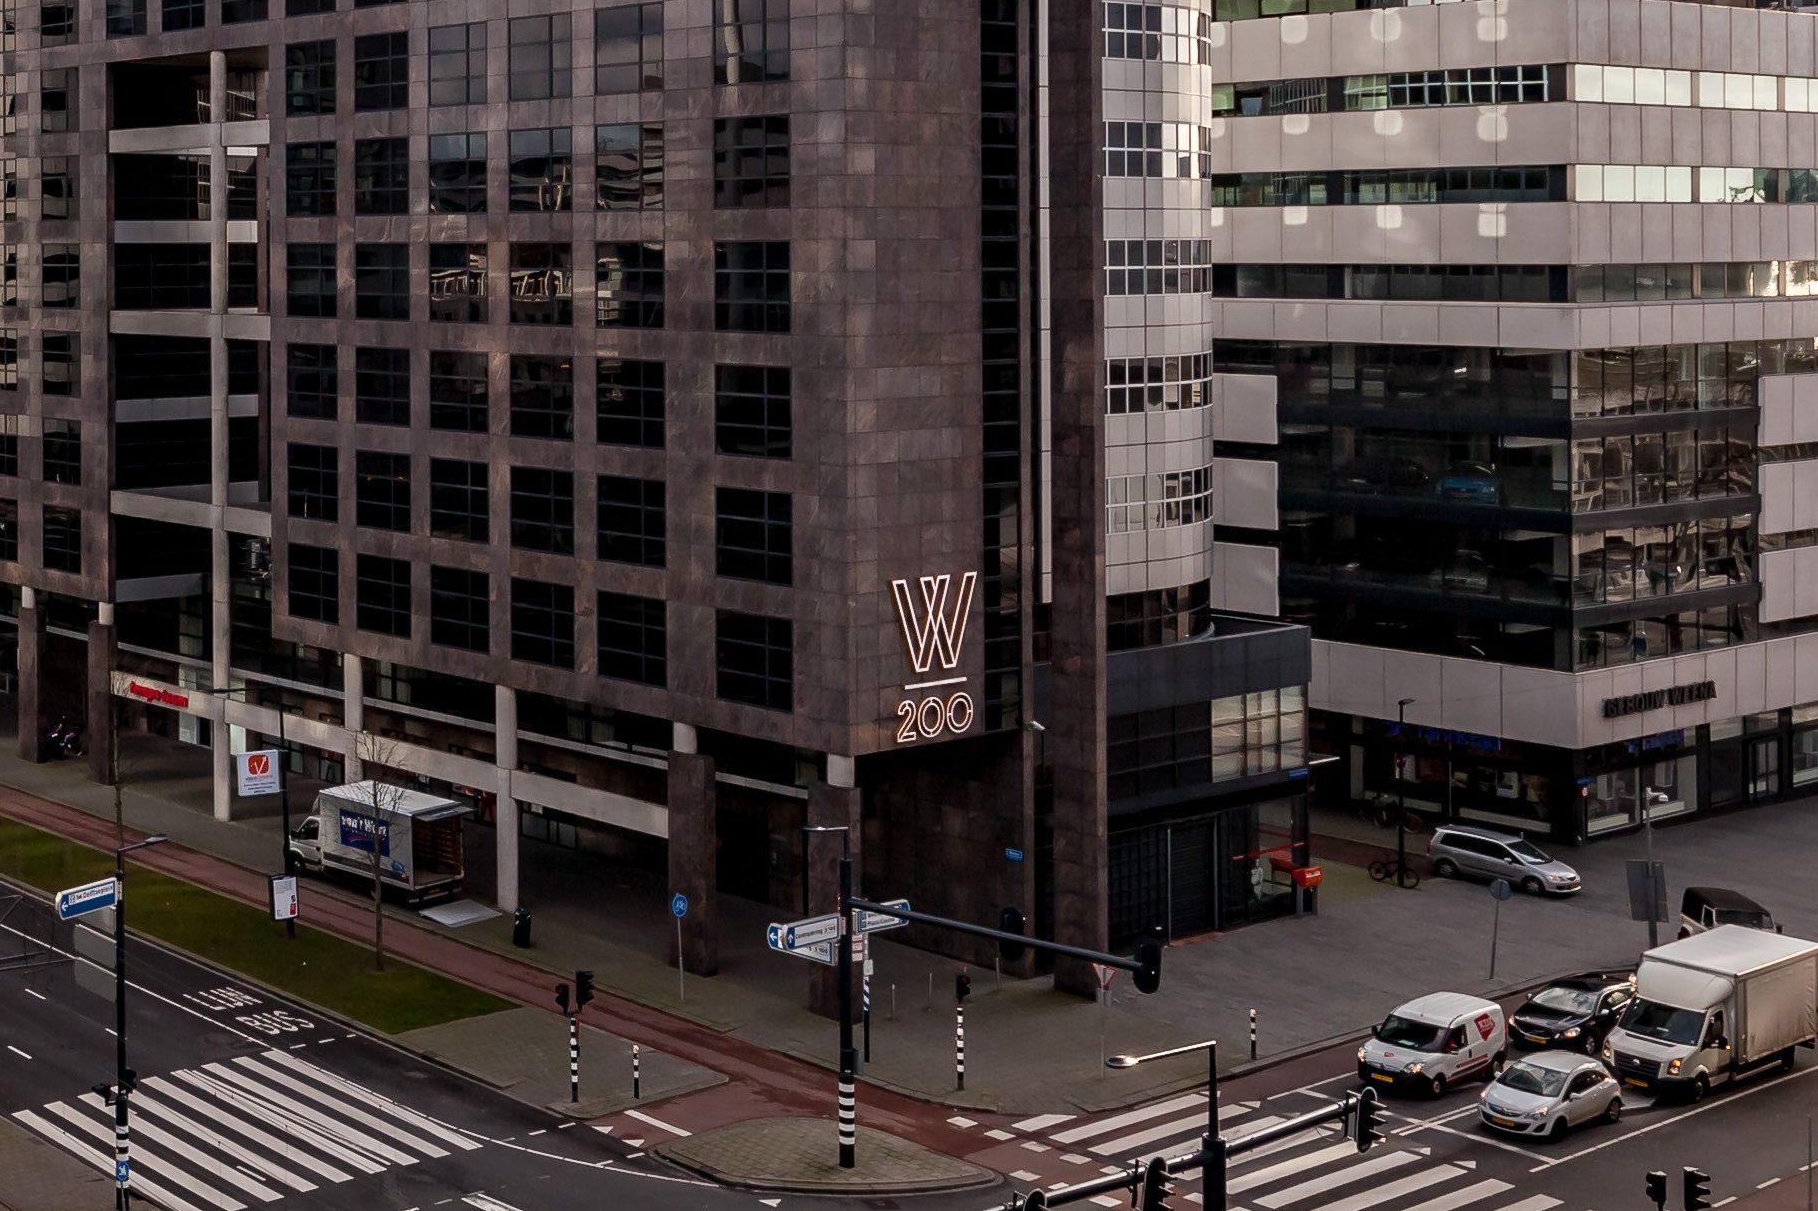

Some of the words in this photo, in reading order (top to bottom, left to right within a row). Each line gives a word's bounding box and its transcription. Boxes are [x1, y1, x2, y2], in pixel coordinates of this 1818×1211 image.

[892, 570, 977, 673] W
[1666, 680, 1718, 706] WEENA
[896, 692, 974, 743] 200
[235, 1010, 314, 1035] BUS
